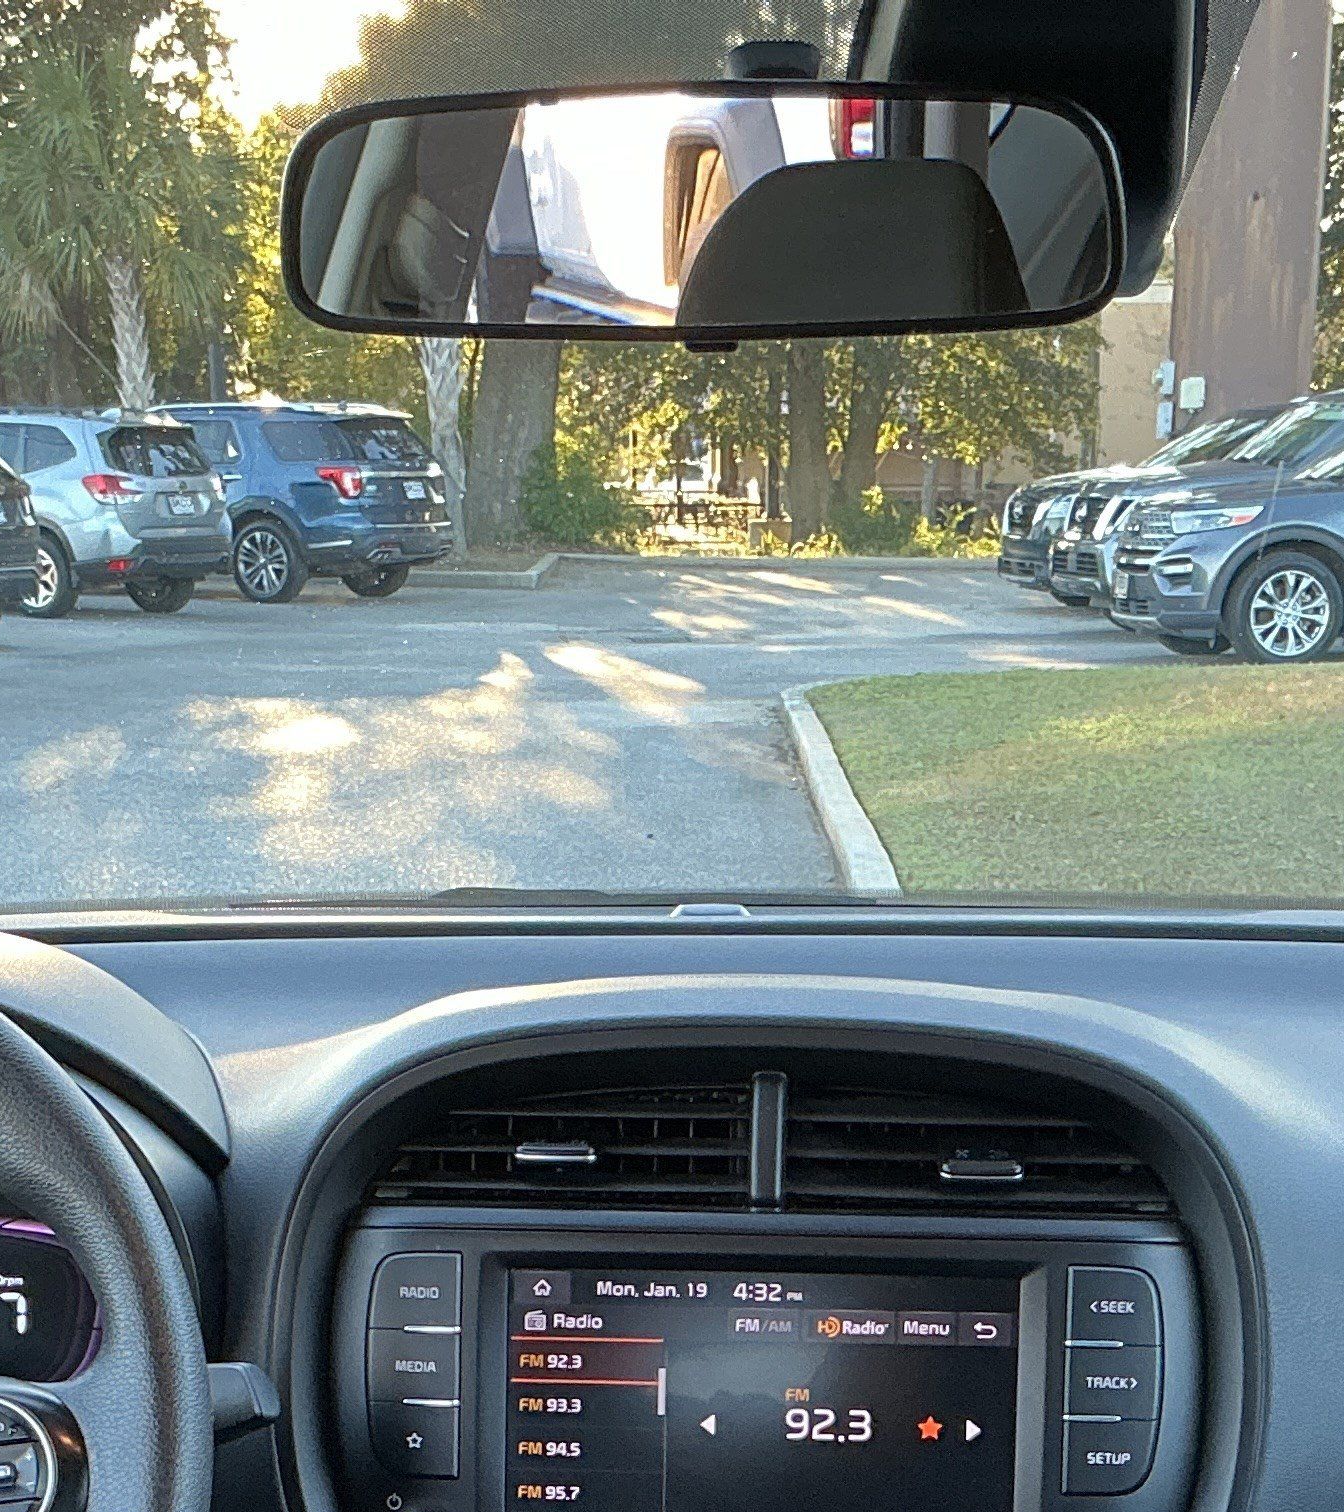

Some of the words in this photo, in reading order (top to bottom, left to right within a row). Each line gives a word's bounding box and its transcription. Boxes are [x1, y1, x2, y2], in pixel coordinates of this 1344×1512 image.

[399, 1286, 440, 1299] RADIO
[688, 1282, 708, 1298] 19
[733, 1283, 782, 1302] 4:32
[553, 1313, 603, 1329] Radio
[735, 1318, 792, 1333] FM/AM
[903, 1320, 950, 1336] Menu
[394, 1359, 437, 1373] MEDIA
[519, 1355, 544, 1369] FM
[547, 1355, 582, 1369] 92.3
[785, 1388, 810, 1402] FM
[519, 1398, 543, 1412] FM
[546, 1398, 582, 1413] 93.3
[785, 1408, 872, 1443] 92.3
[518, 1441, 543, 1455] FM
[545, 1442, 581, 1457] 94.5
[1086, 1452, 1131, 1466] SETUP
[517, 1485, 542, 1499] FM
[545, 1486, 580, 1500] 95.7
